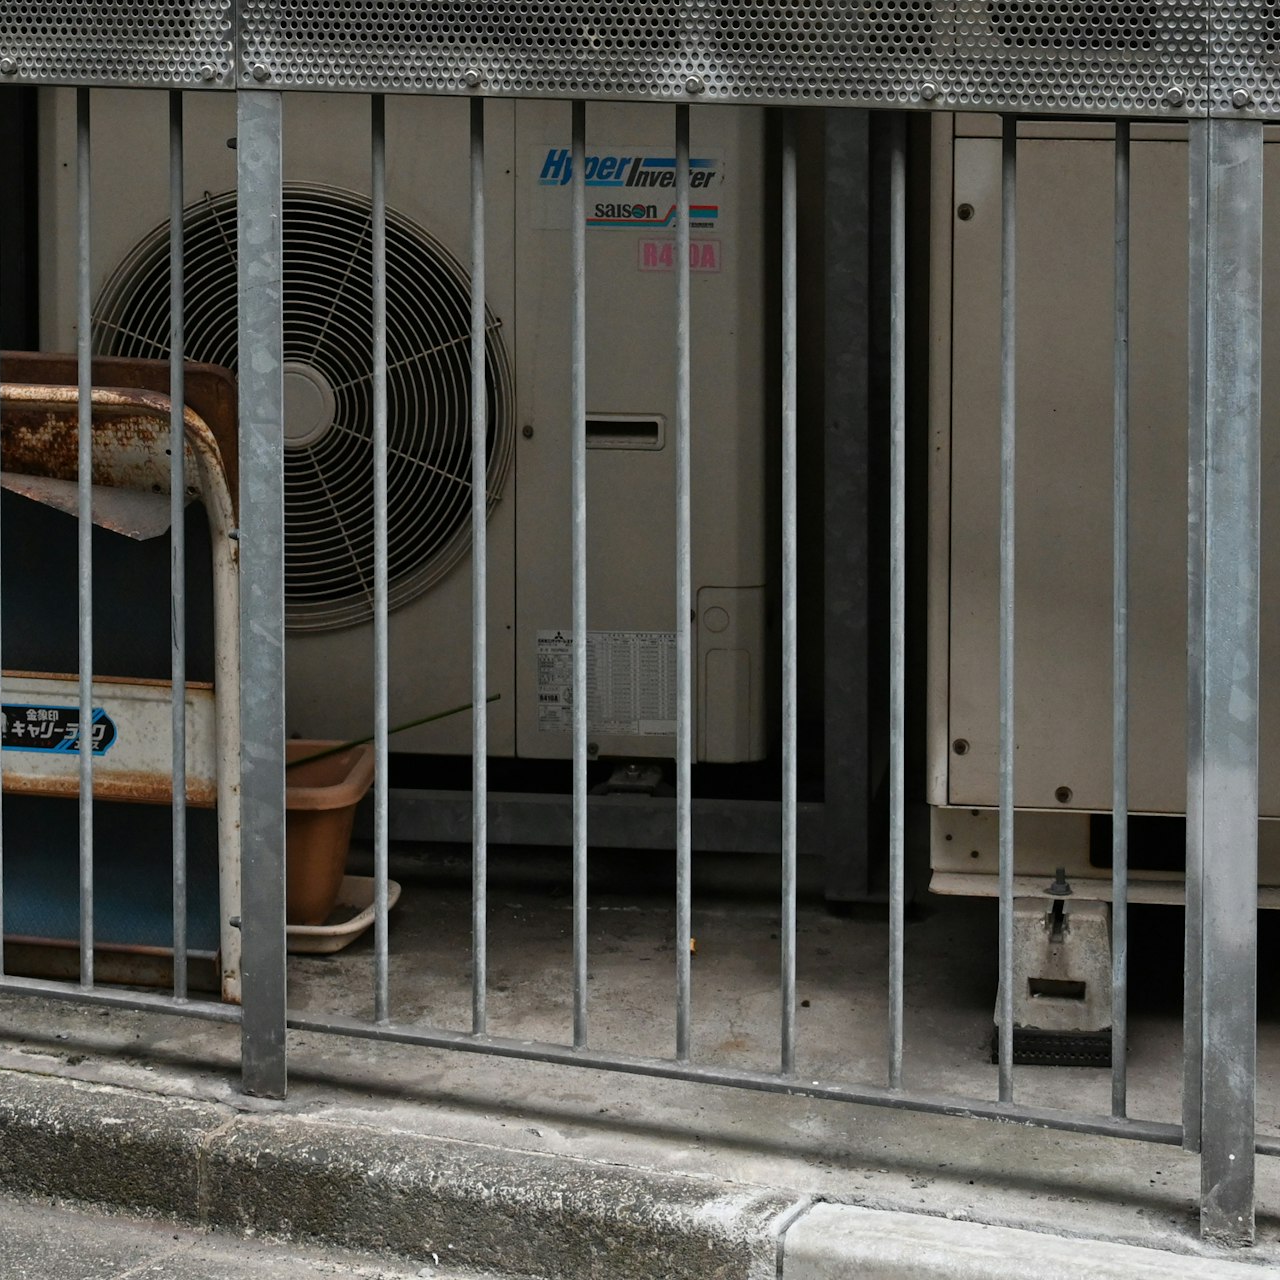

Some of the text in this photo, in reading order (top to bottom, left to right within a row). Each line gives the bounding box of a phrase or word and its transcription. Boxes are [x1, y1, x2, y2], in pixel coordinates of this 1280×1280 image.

[626, 158, 715, 188] Inveer
[595, 204, 657, 218] saison
[643, 243, 716, 268] R40A
[11, 720, 107, 742] キャリーラク
